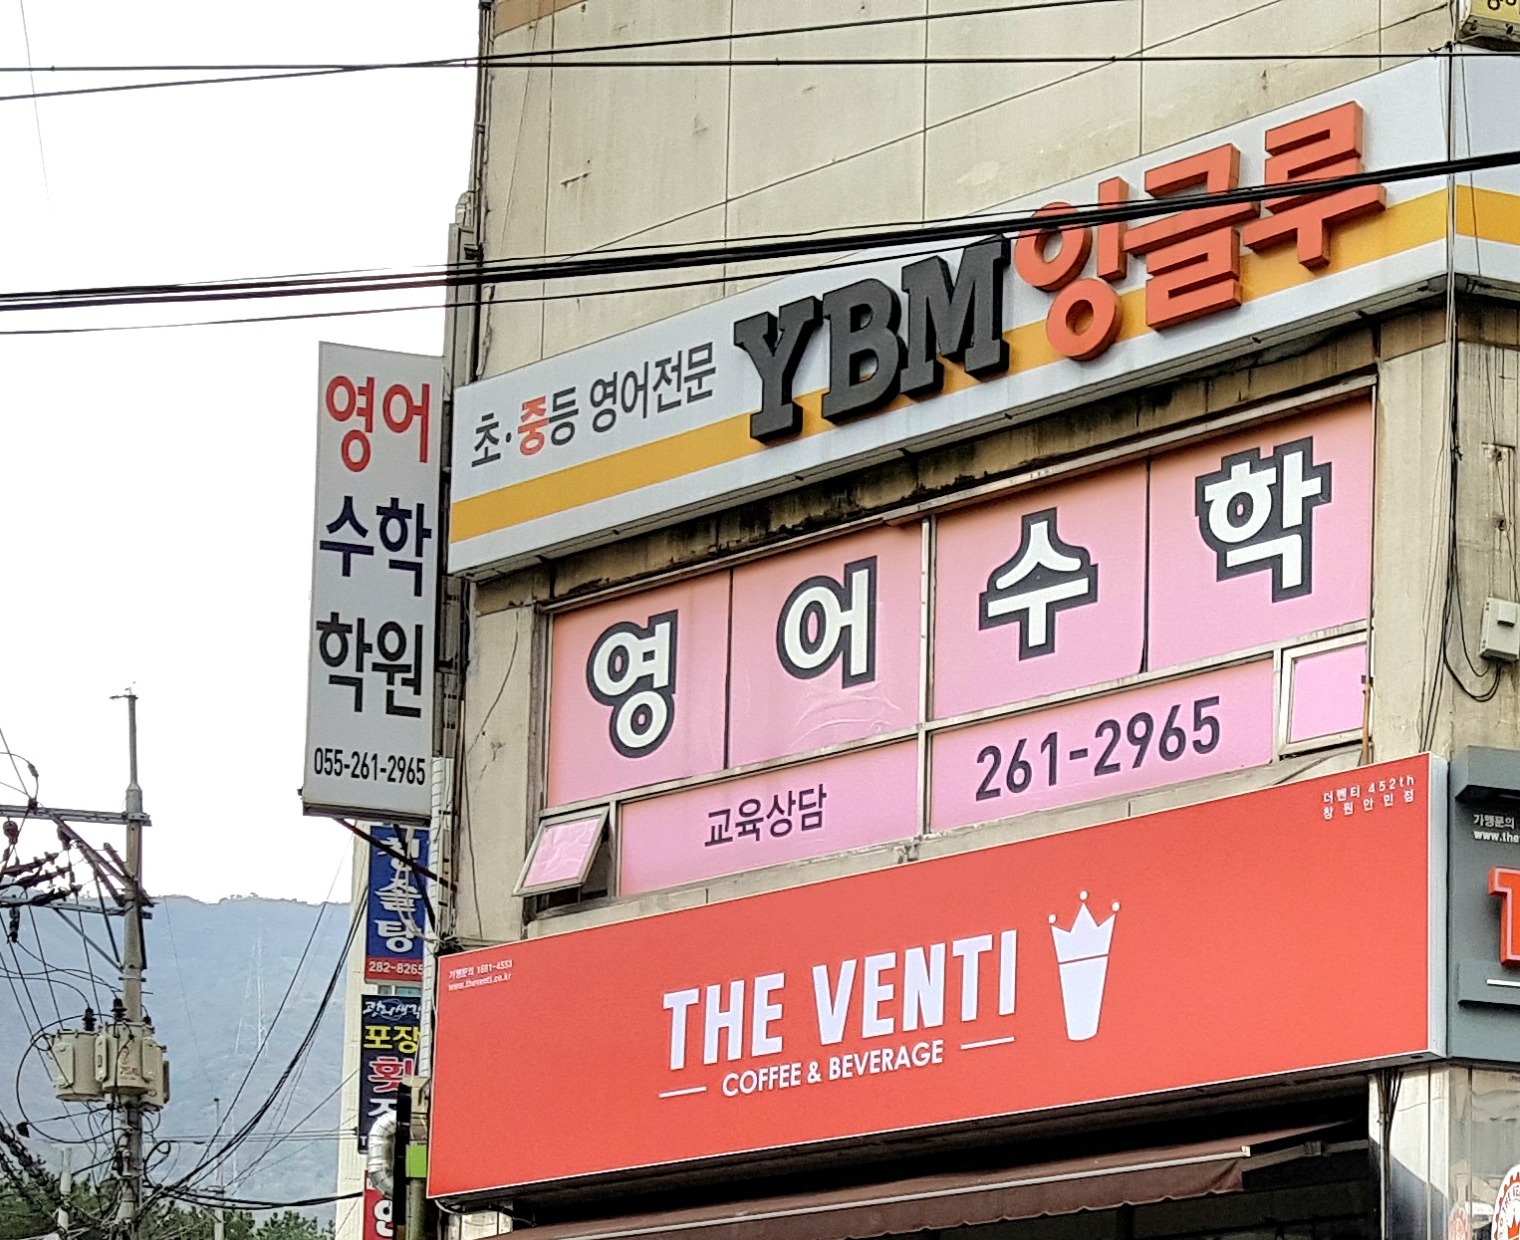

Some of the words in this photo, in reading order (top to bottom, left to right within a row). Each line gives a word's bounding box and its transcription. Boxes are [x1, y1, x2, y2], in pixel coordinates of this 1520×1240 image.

[589, 342, 718, 434] 영어전문
[733, 237, 1010, 444] YBM
[1013, 100, 1387, 361] 잉글루
[326, 375, 430, 472] 영어
[319, 495, 432, 597] 수학
[316, 611, 423, 719] 학원
[314, 747, 425, 785] 055-261-2965
[974, 696, 1220, 802] 261-2965
[1368, 775, 1414, 793] 452th
[704, 785, 827, 851] 교육상담
[1473, 814, 1514, 829] 가맹문의
[368, 960, 423, 976] 282-8265
[662, 972, 785, 1072] THE
[812, 929, 1018, 1047] VENTI
[363, 1025, 420, 1054] 포장
[722, 1062, 801, 1098] COFFEE
[807, 1064, 821, 1084] &
[828, 1040, 944, 1082] BEVERAGE
